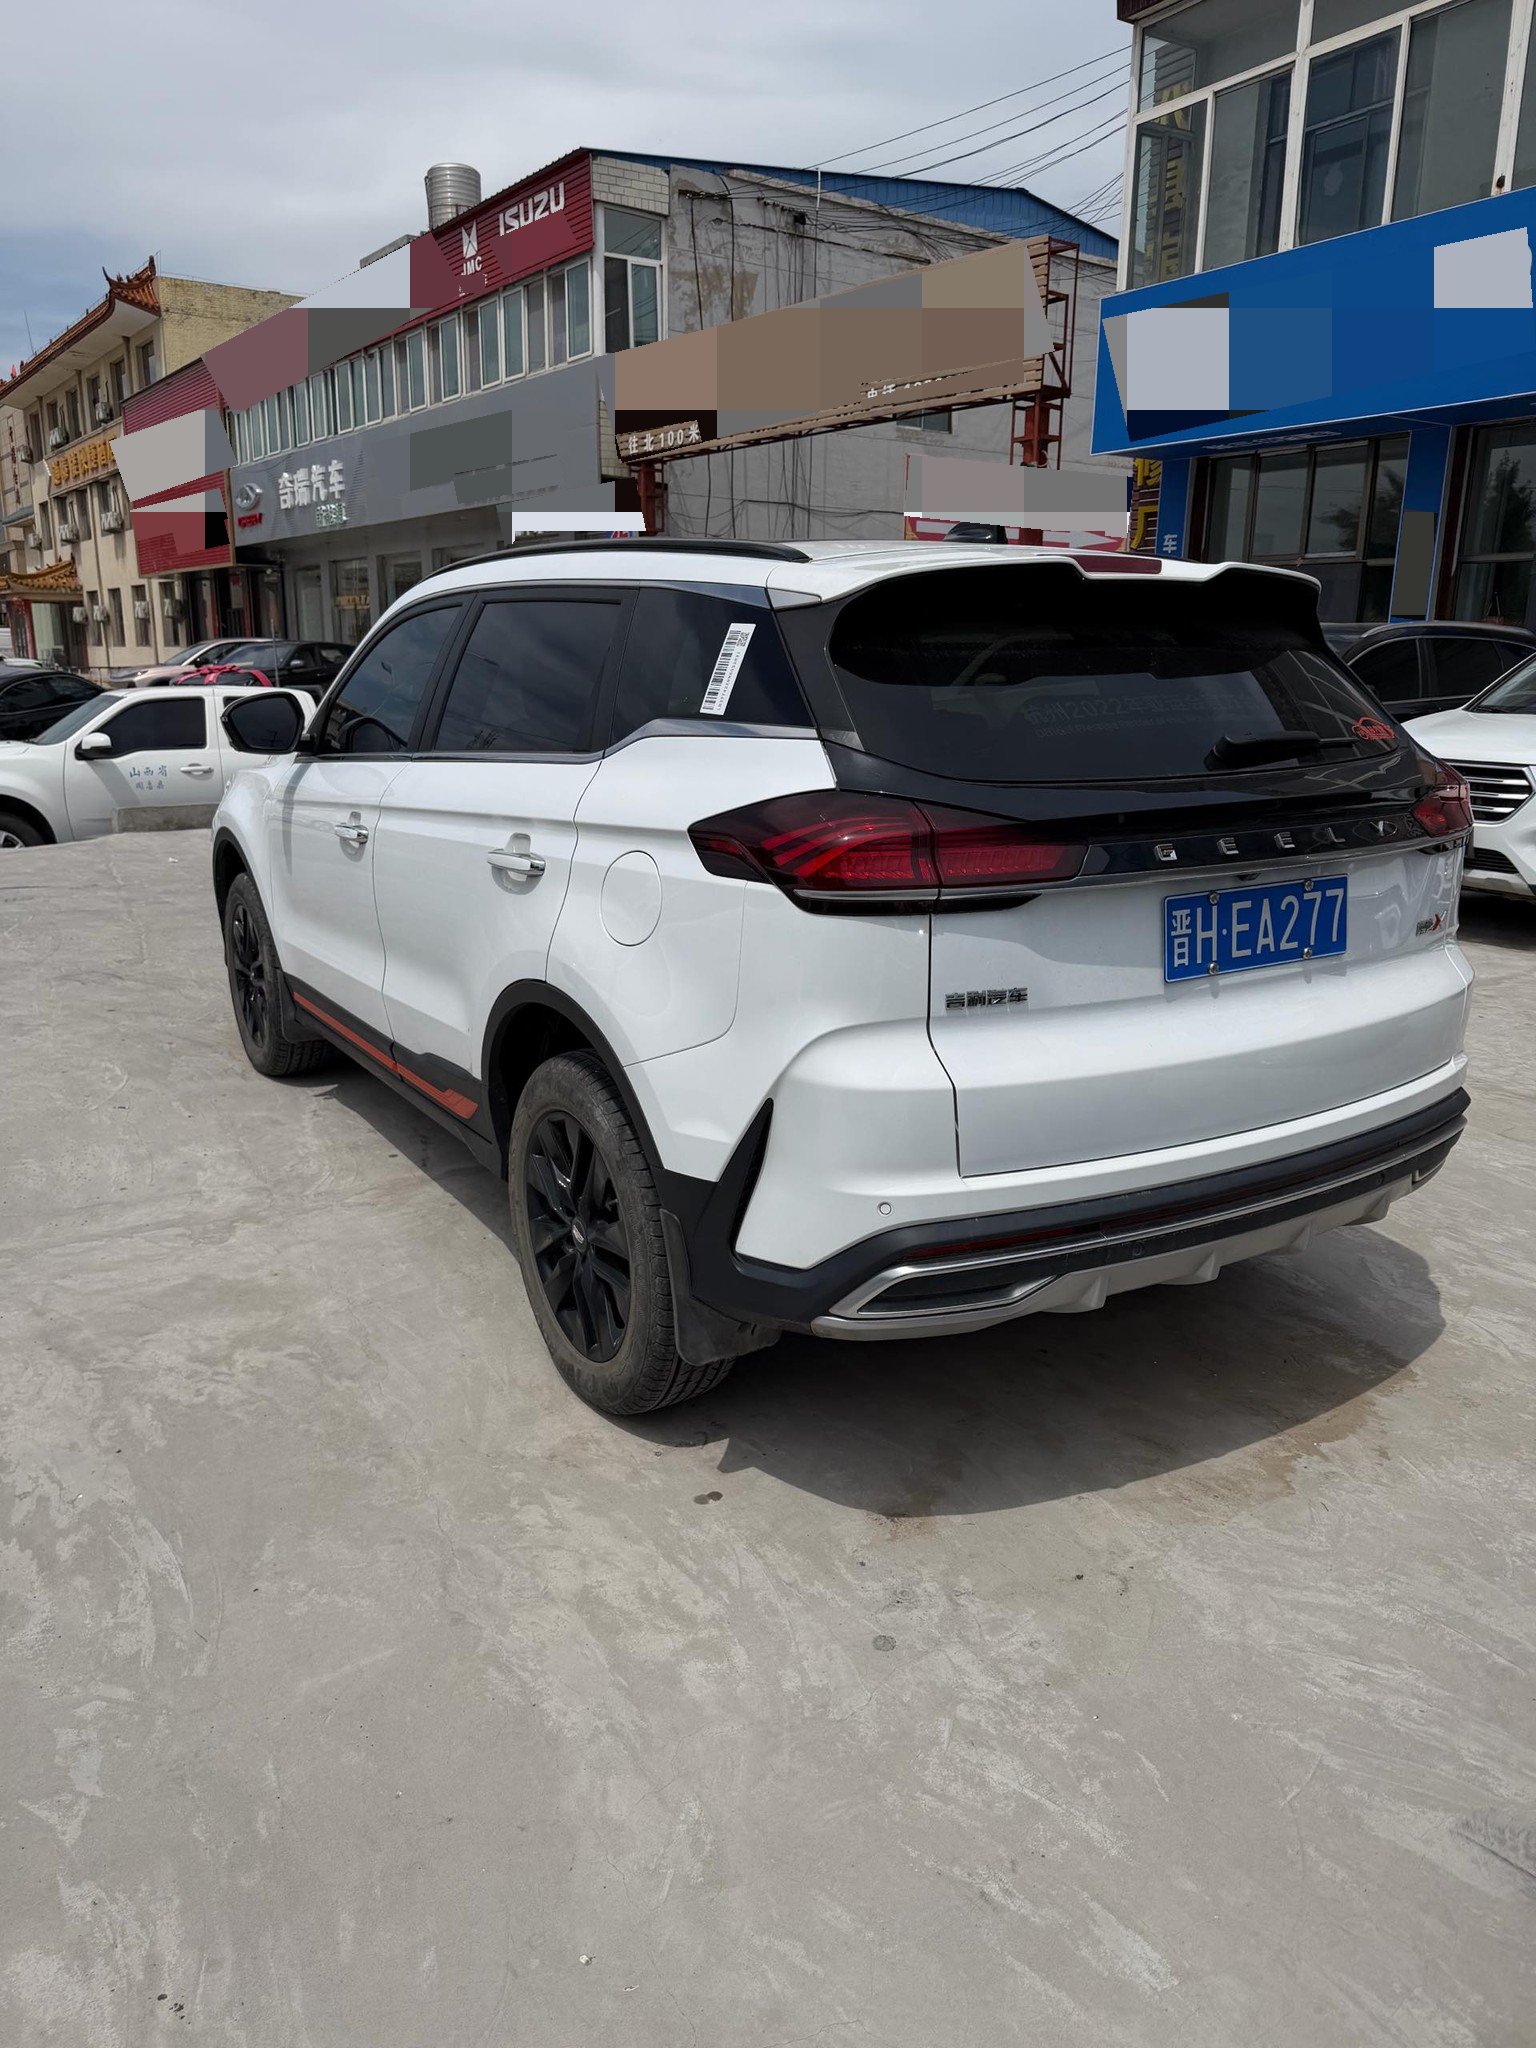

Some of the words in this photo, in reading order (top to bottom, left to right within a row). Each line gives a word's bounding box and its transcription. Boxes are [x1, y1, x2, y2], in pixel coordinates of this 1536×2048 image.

[499, 182, 565, 236] ISUZU
[629, 423, 700, 454] 往北100米
[278, 460, 346, 509] 奇瑞汽车
[1163, 534, 1178, 553] 车
[129, 765, 167, 777] 山西省
[1154, 820, 1397, 861] GEELY
[945, 987, 1028, 1010] 吉利汽车
